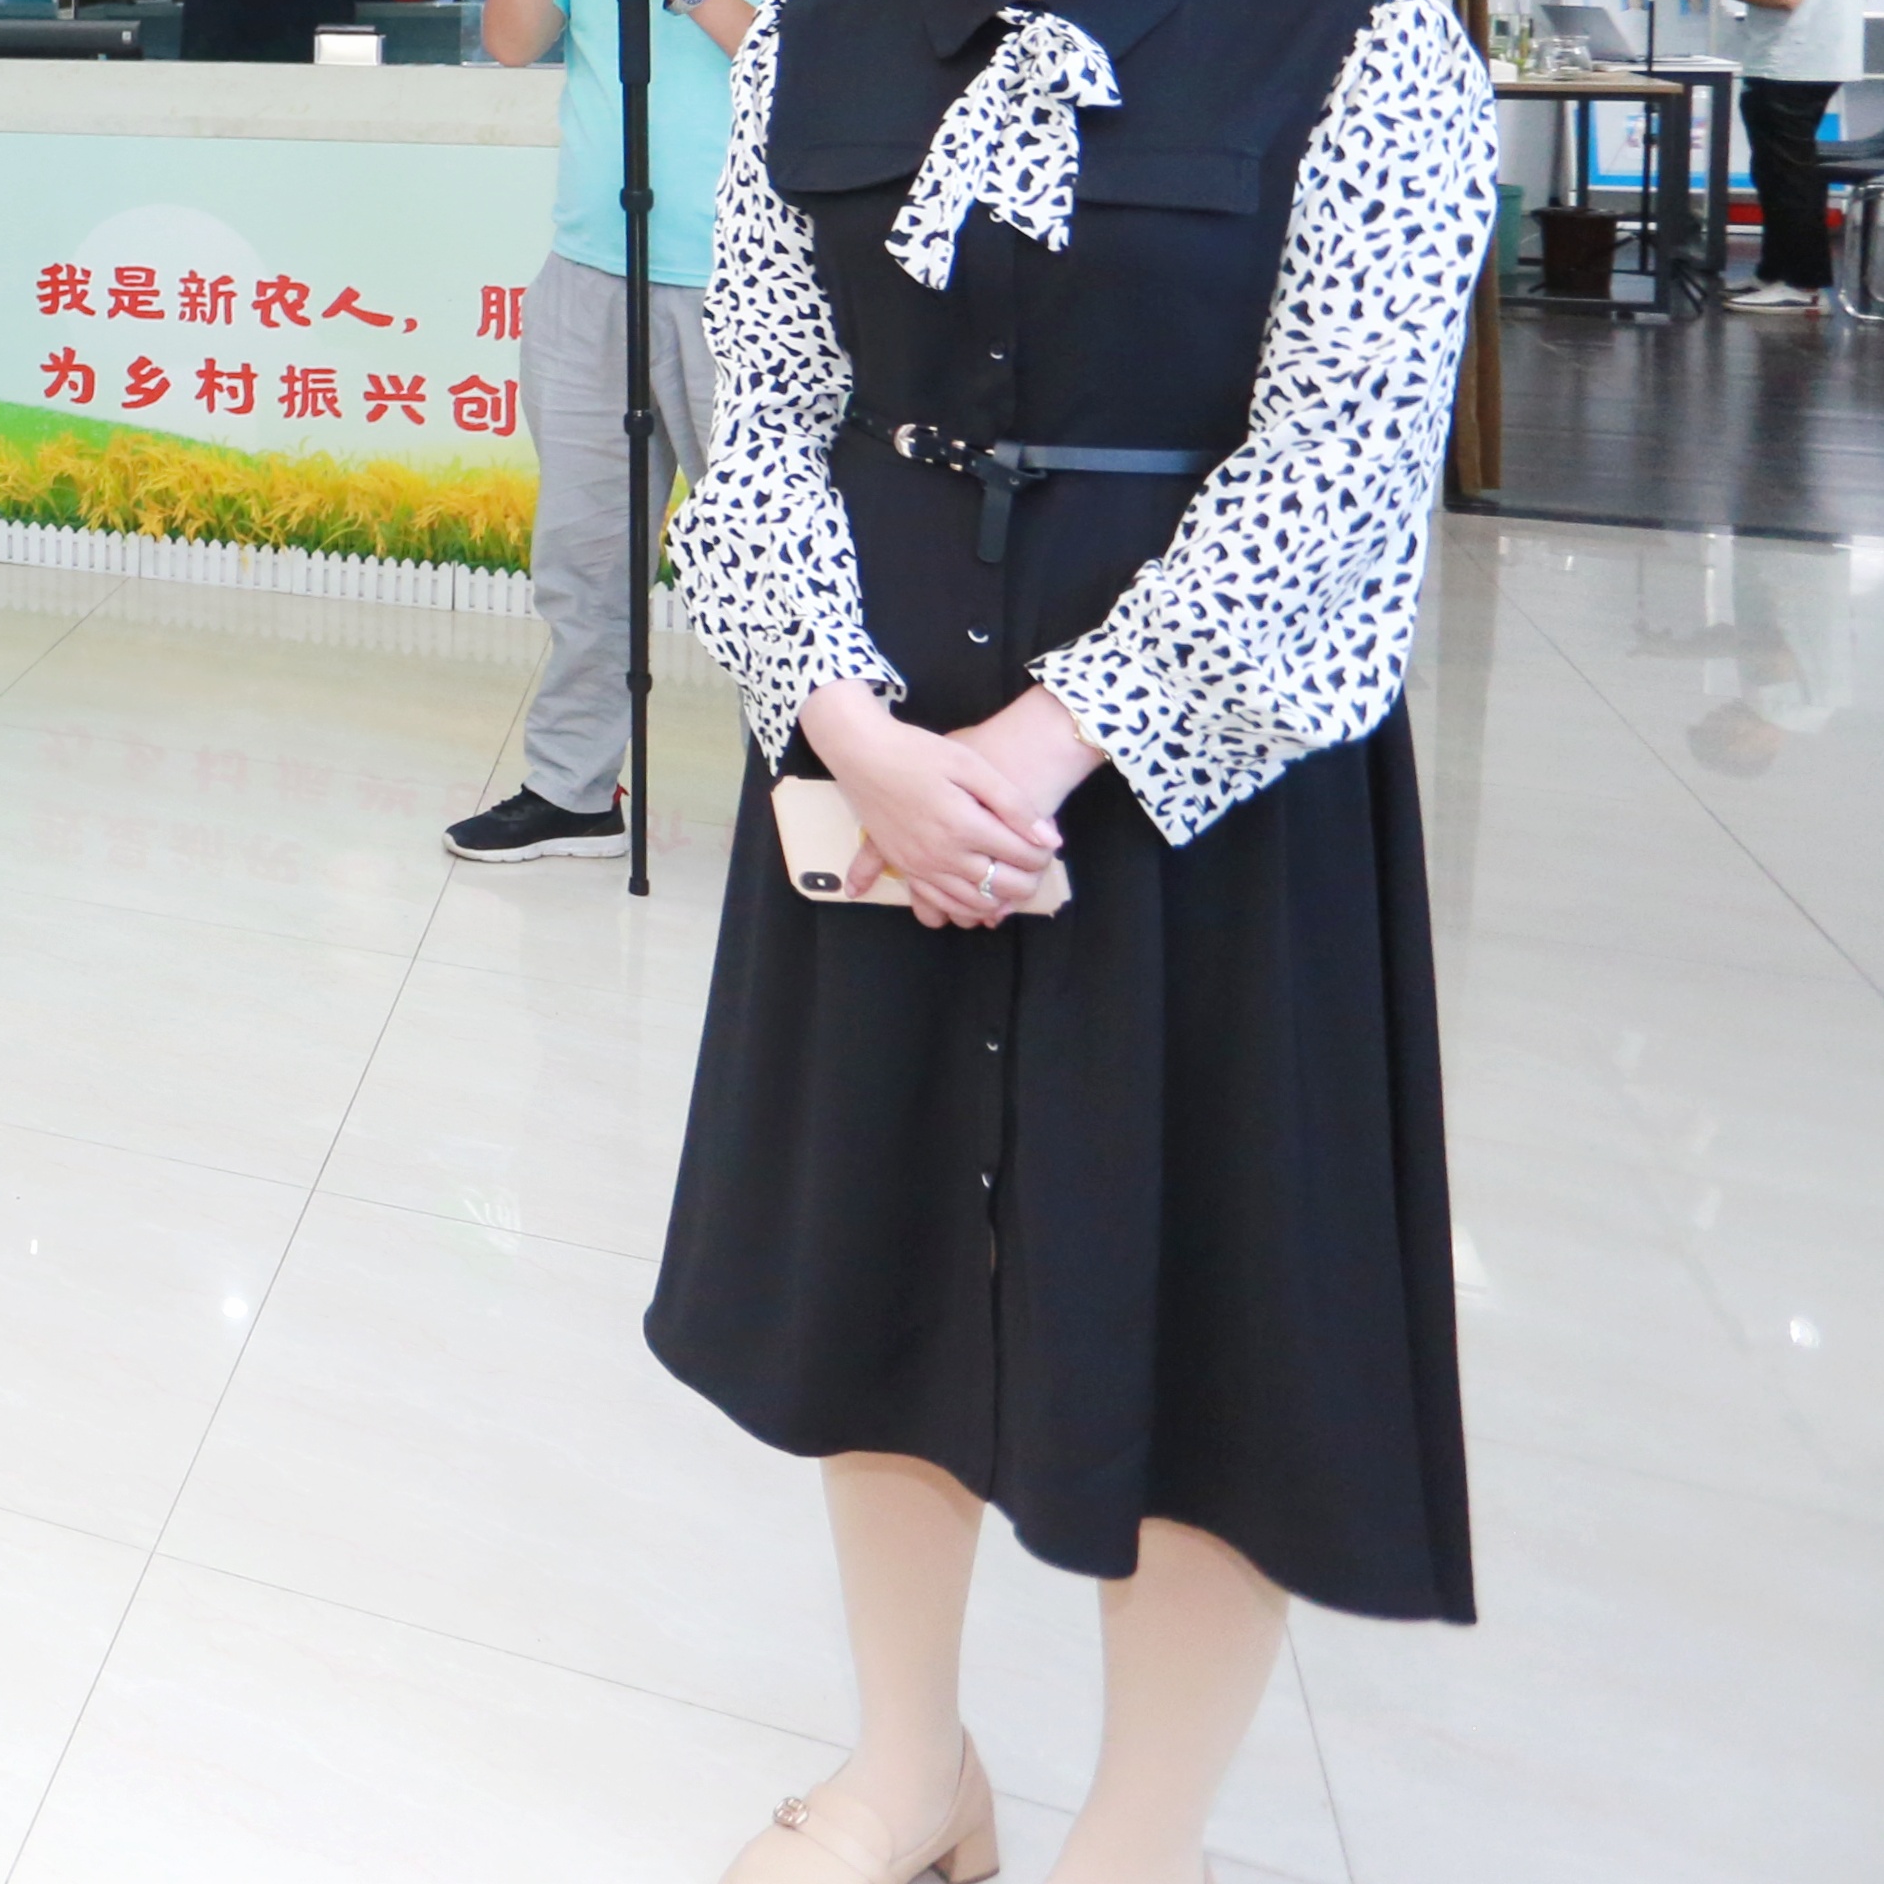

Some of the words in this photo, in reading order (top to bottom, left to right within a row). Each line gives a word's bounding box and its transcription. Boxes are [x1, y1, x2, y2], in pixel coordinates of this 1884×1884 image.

[39, 346, 518, 437] 为乡村振兴创
